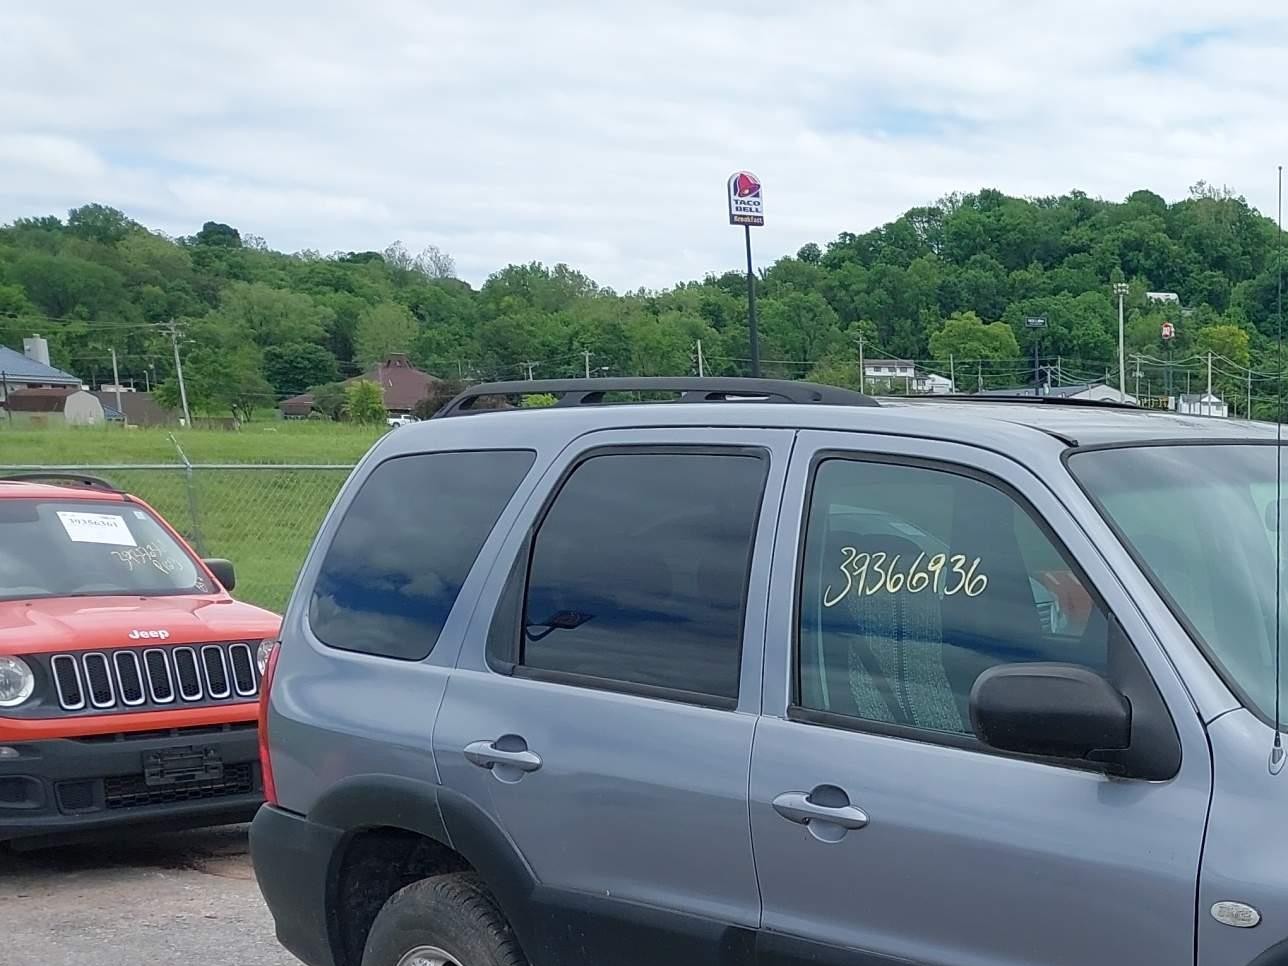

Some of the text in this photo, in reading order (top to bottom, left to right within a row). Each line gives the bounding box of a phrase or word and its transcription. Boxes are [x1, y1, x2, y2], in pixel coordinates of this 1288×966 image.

[733, 199, 761, 207] TACO
[823, 546, 989, 608] 39366936
[127, 628, 170, 640] Jeep
